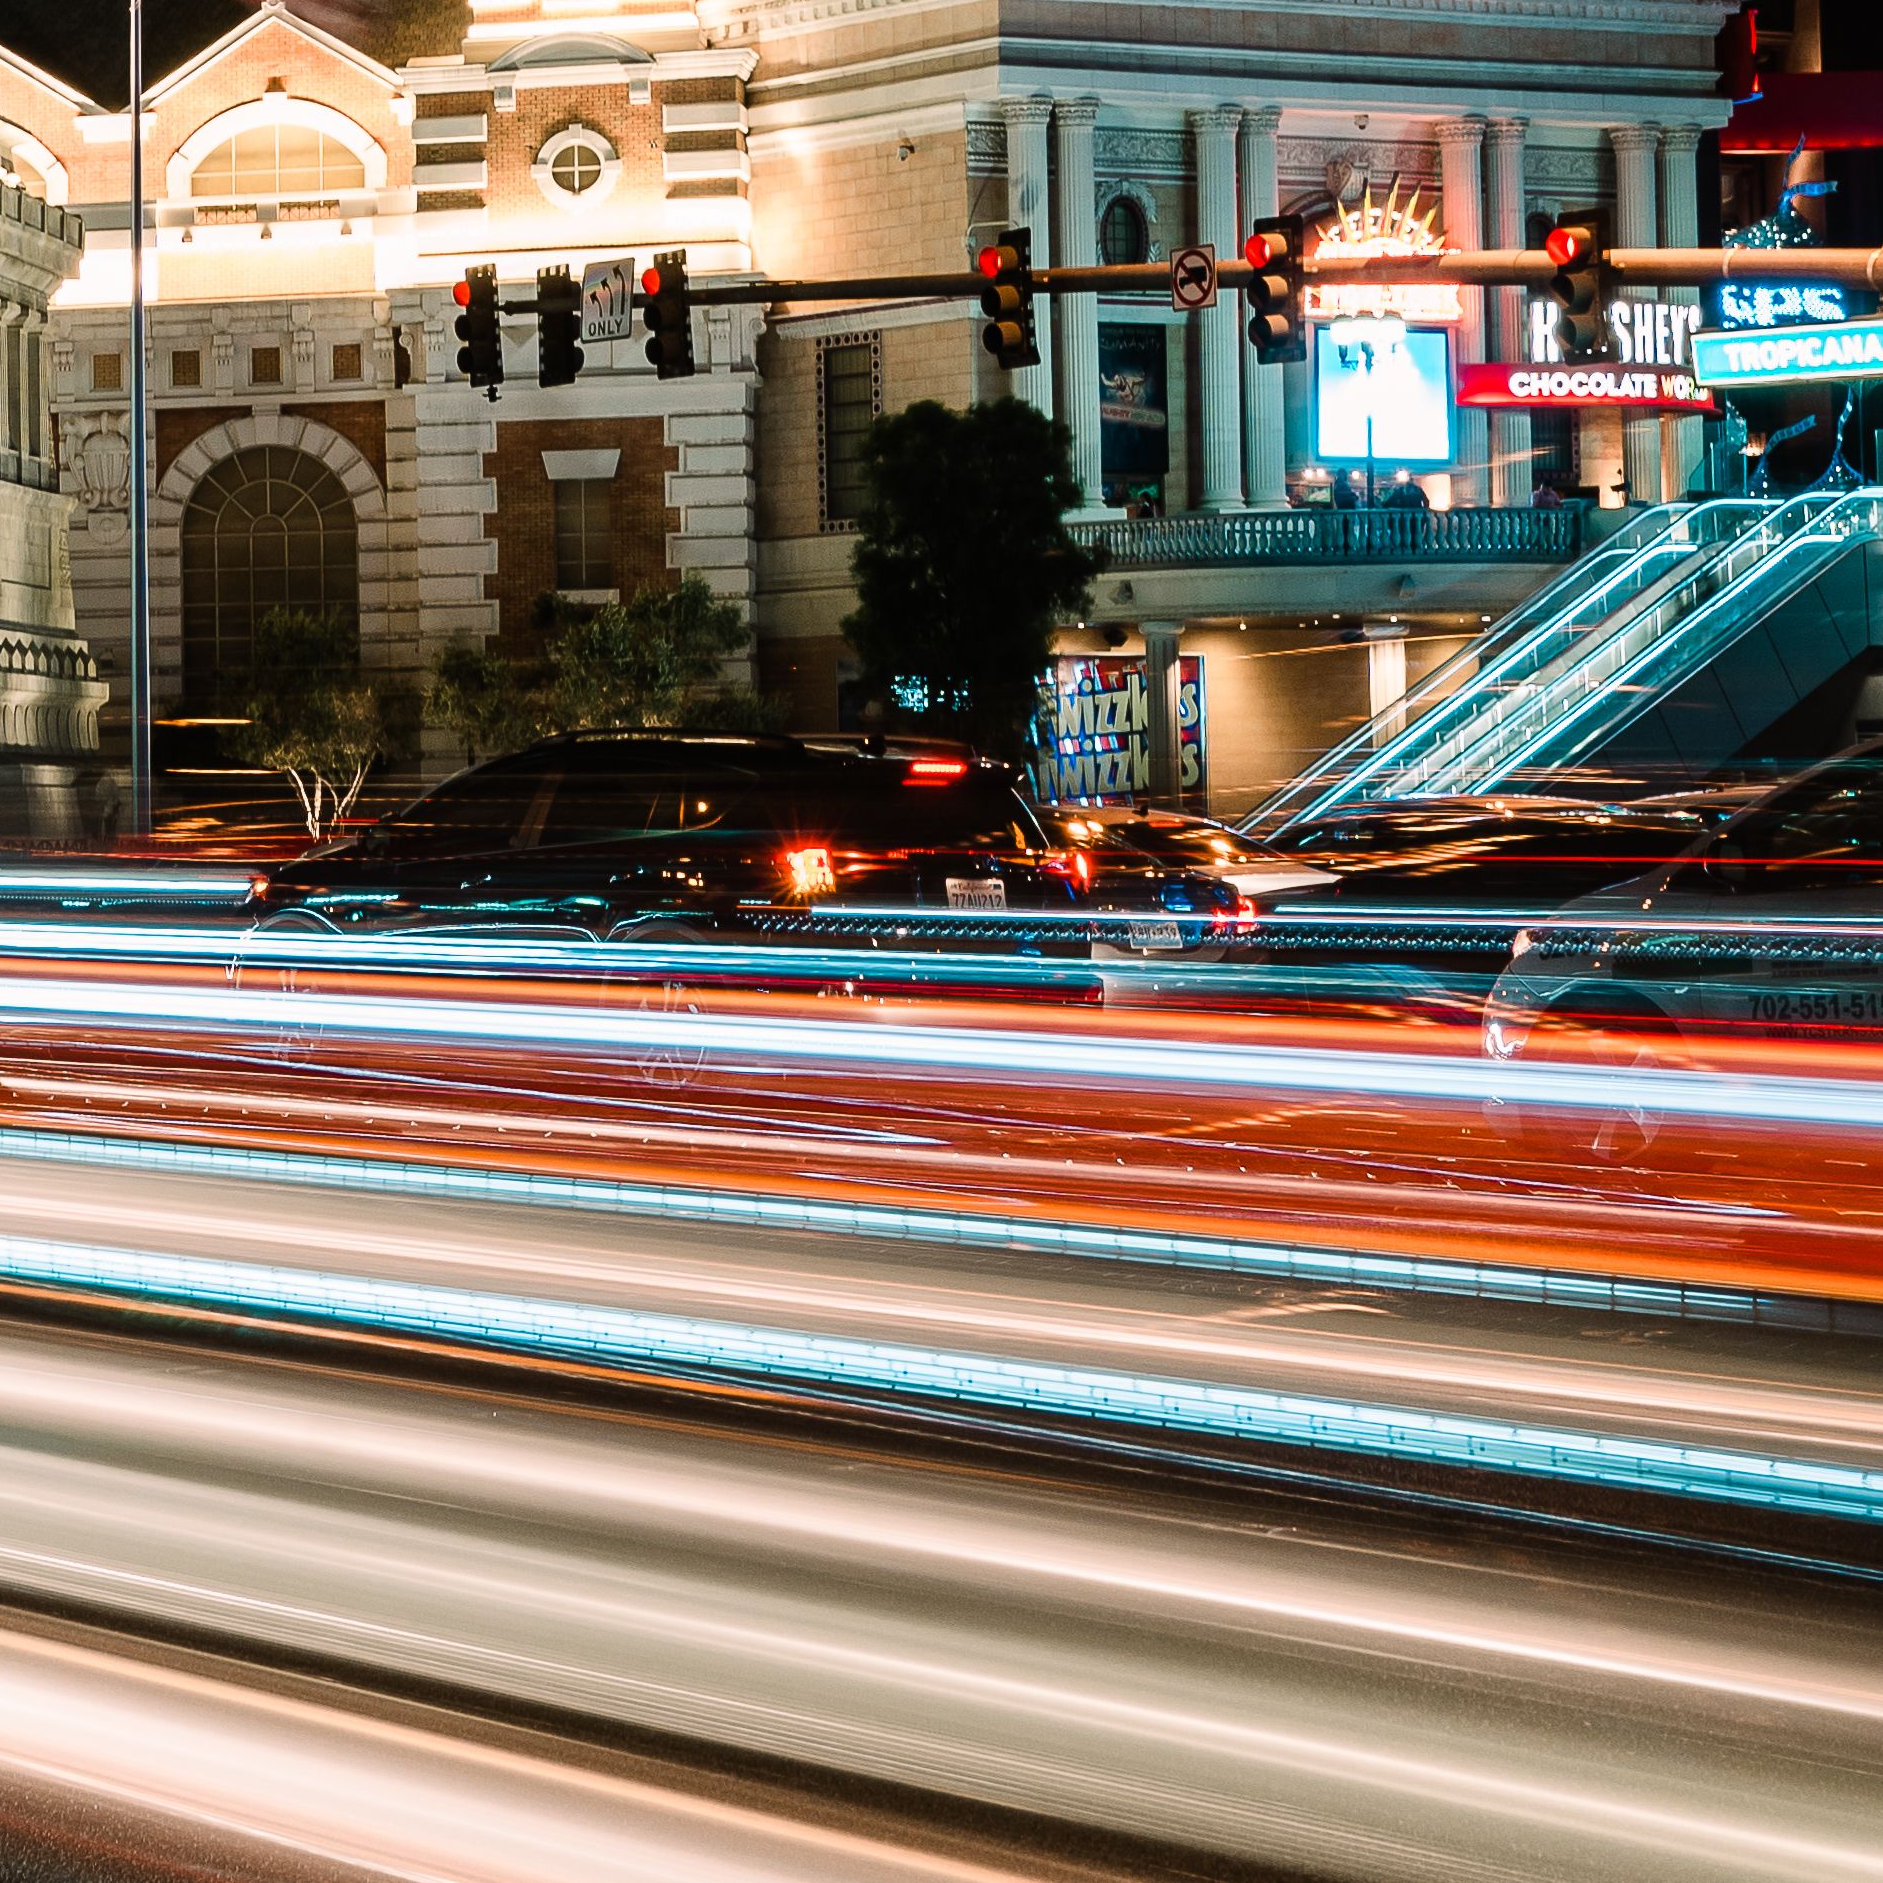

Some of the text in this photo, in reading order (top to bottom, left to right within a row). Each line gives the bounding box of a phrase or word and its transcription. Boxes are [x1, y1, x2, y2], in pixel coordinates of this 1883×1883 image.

[589, 318, 623, 336] ONLY
[1530, 299, 1702, 365] HSHEY'
[1722, 332, 1883, 372] TROPICANA
[1508, 371, 1709, 401] CHOCOLATE WOR
[1747, 994, 1883, 1021] 702-551-51
